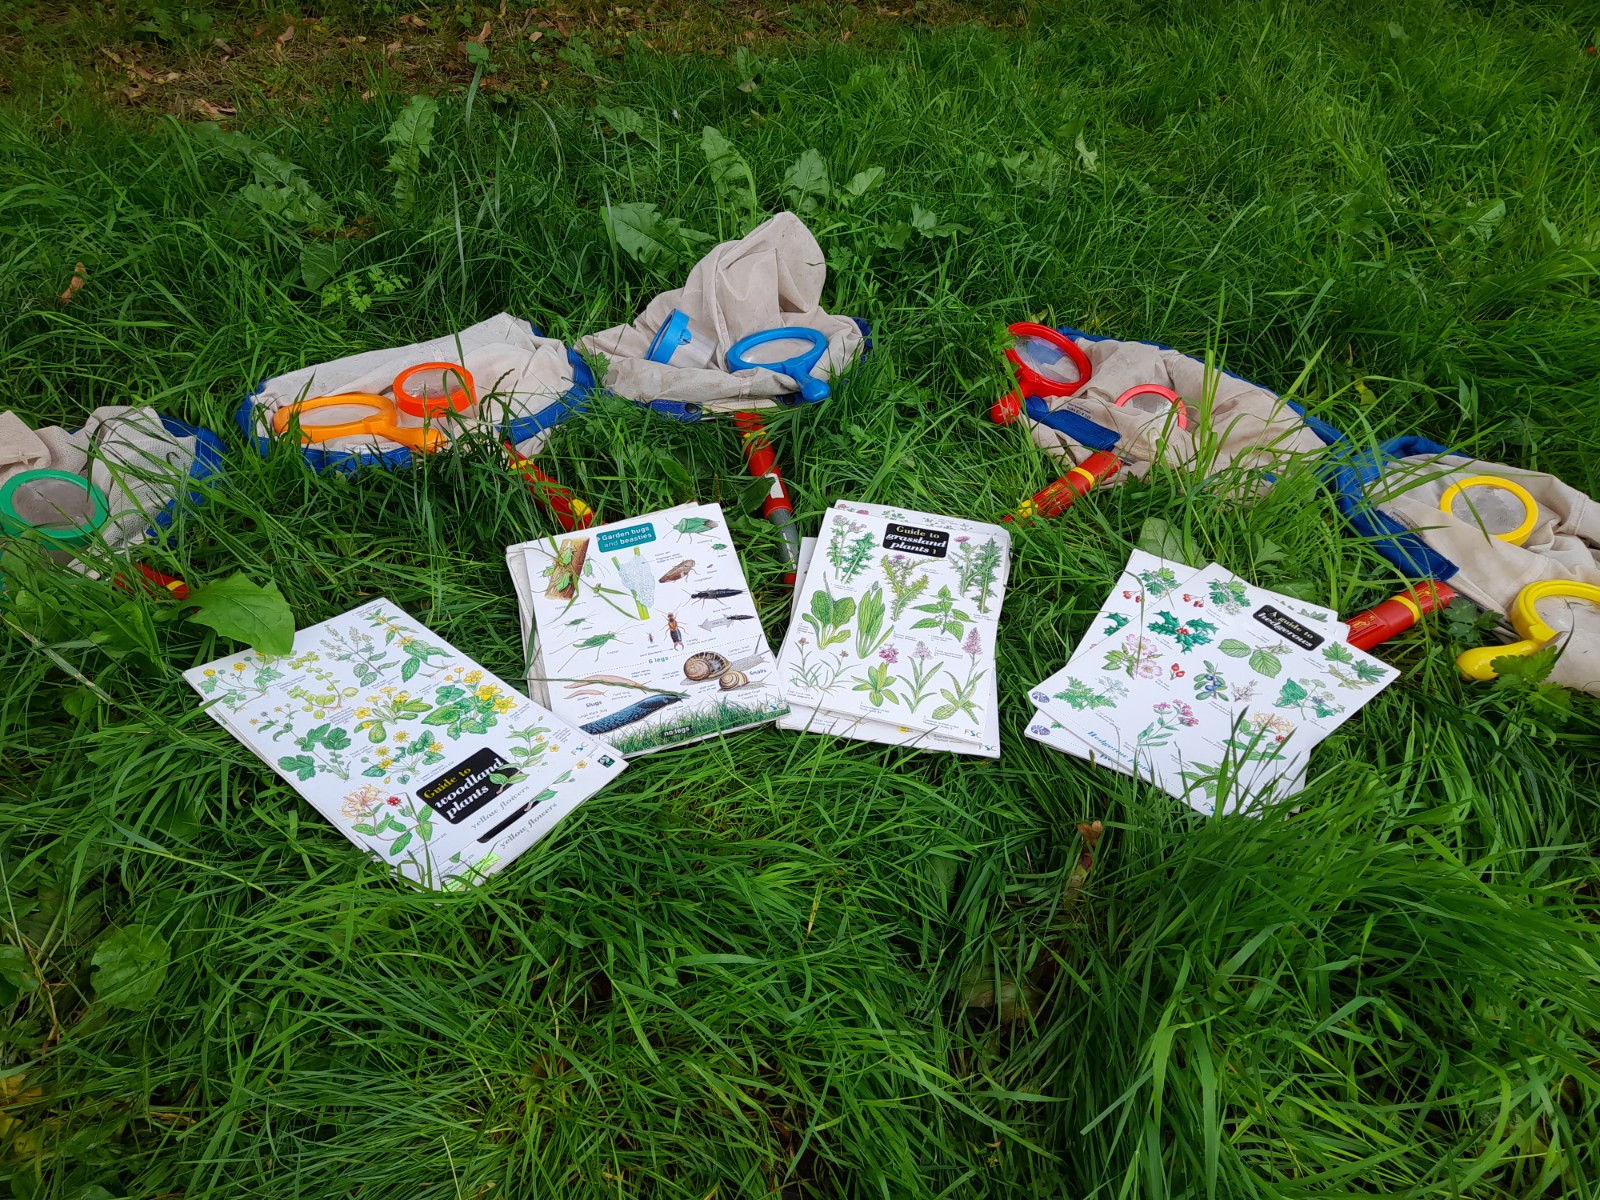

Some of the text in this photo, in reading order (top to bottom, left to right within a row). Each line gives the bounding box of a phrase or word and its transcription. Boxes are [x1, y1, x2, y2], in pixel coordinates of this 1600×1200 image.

[601, 526, 650, 541] Garden bugs
[895, 525, 926, 537] Guide
[604, 533, 653, 548] and beasties
[885, 533, 947, 548] grassland
[889, 542, 930, 553] plants
[1257, 612, 1314, 648] hedgerows
[1269, 611, 1314, 639] A guide to
[654, 656, 669, 664] legs
[585, 700, 603, 708] Slugs
[675, 726, 690, 735] legs
[423, 768, 472, 799] Guide to
[434, 757, 504, 809] woodland
[446, 785, 489, 820] plants
[471, 785, 530, 831] yellow flowers
[500, 802, 558, 849] yellow flowers
